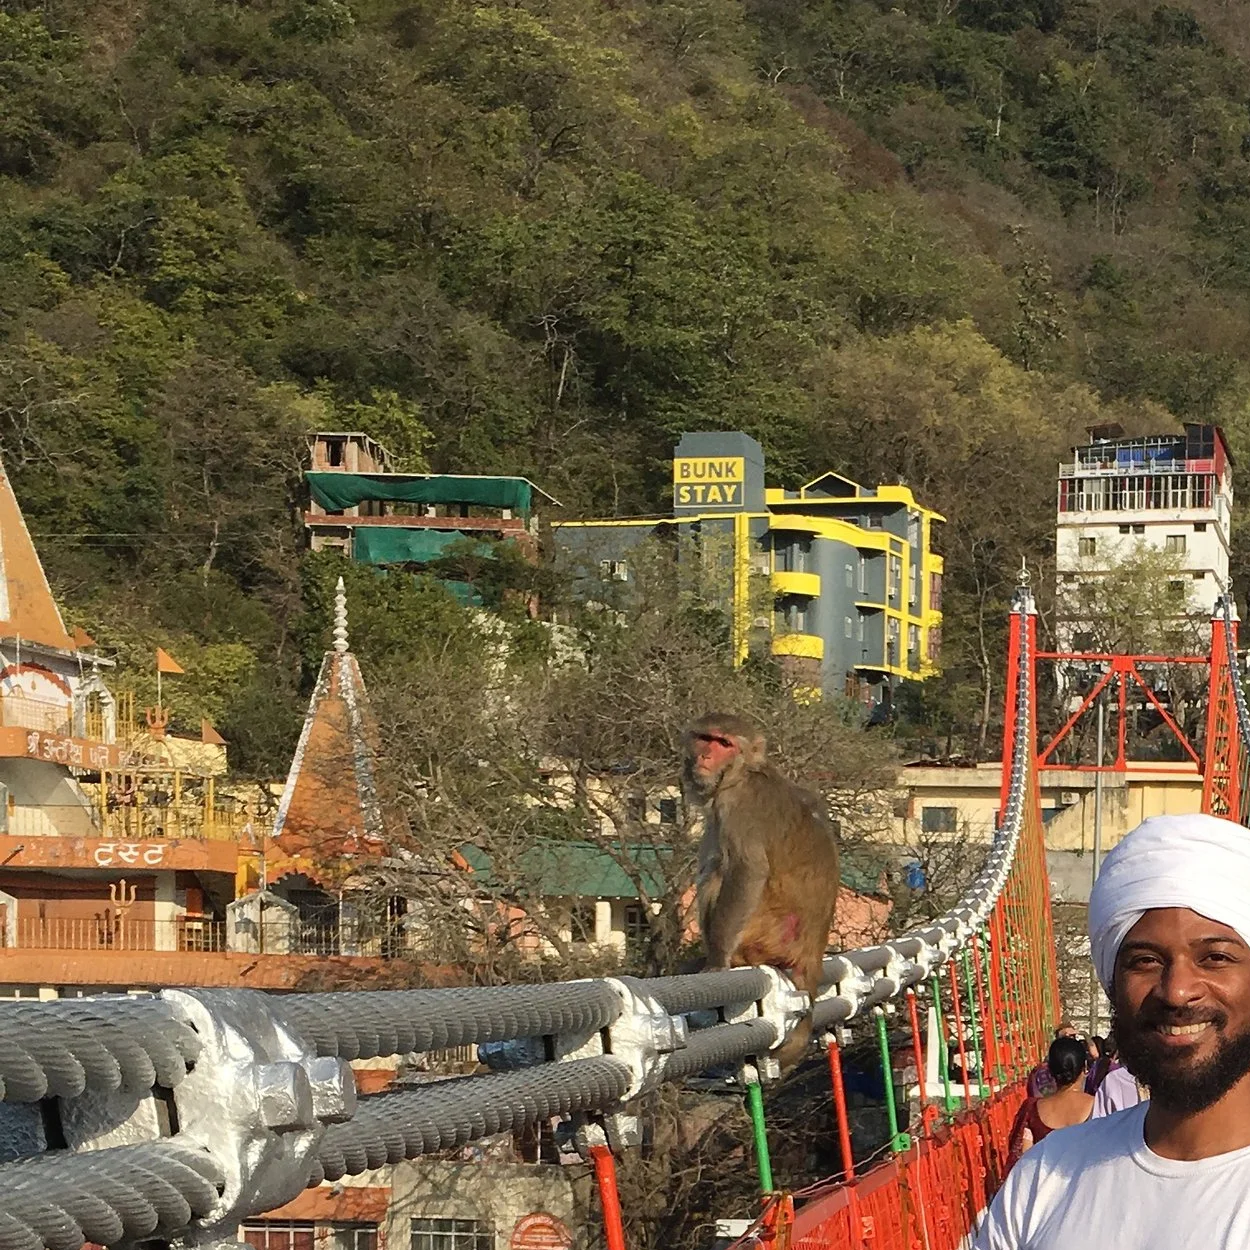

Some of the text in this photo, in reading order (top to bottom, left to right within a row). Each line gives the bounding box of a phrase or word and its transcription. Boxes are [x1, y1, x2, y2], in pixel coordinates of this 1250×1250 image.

[680, 461, 737, 479] BUNK
[680, 485, 737, 503] STAY
[94, 842, 169, 867] ट्रस्ट
